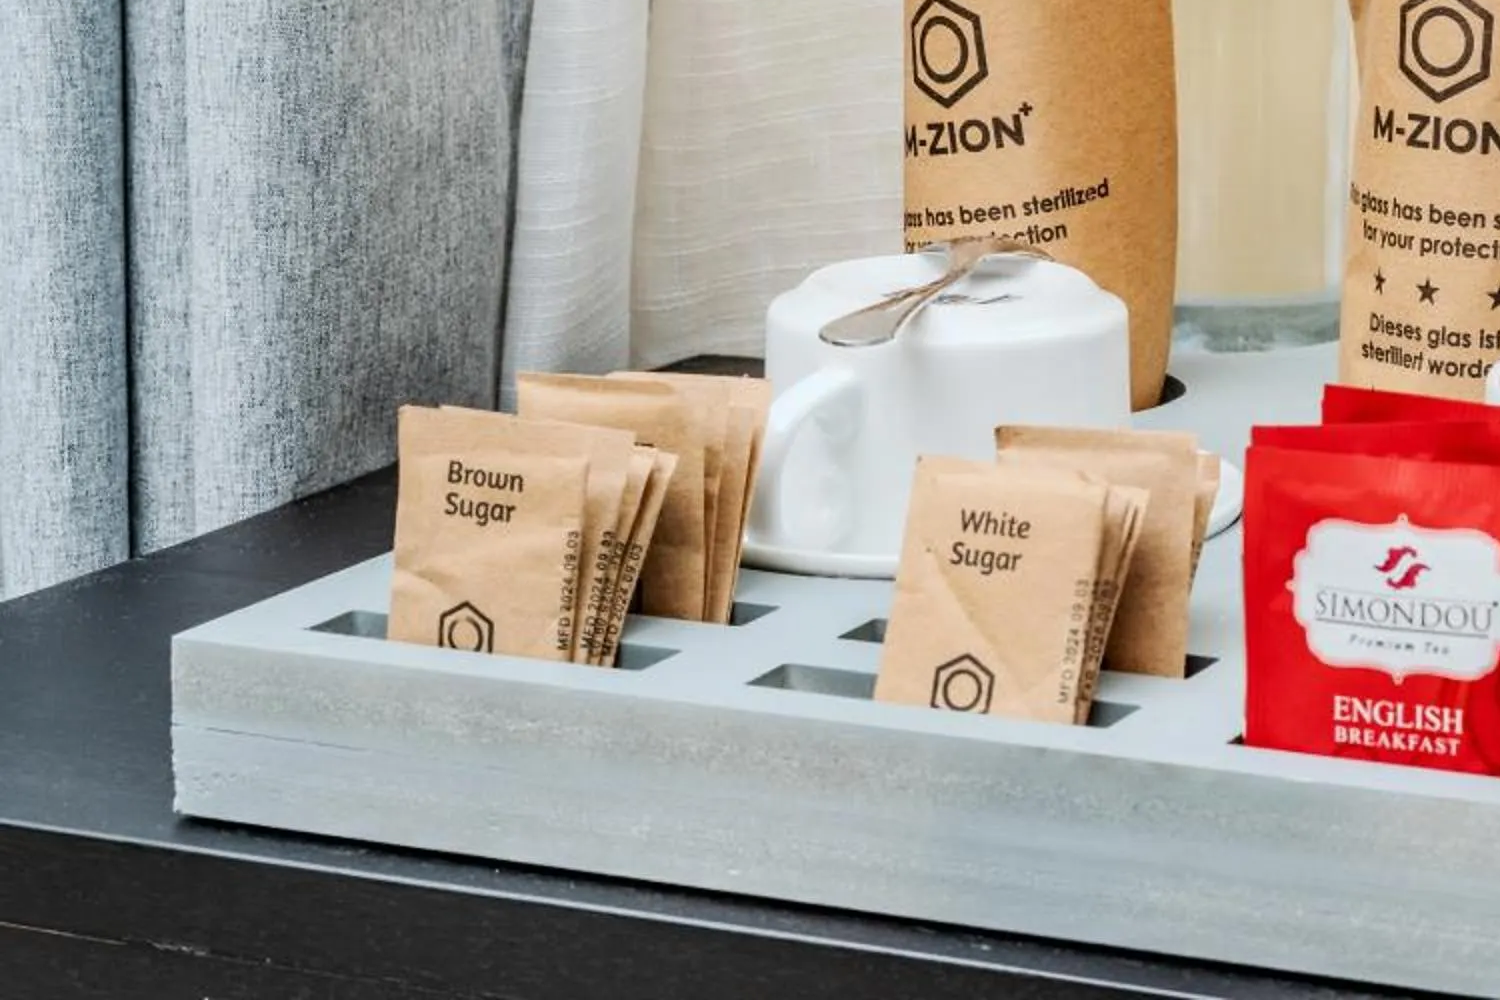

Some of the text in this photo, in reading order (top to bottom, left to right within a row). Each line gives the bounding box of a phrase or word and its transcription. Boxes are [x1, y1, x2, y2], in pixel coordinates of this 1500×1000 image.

[925, 207, 954, 227] has
[959, 203, 1016, 225] been
[1022, 178, 1109, 217] sterilized
[1361, 191, 1389, 214] glass
[1392, 197, 1423, 222] has
[1429, 204, 1486, 228] been
[1381, 227, 1415, 250] your
[1369, 311, 1422, 342] Dieses
[1427, 325, 1472, 349] glas
[447, 461, 524, 493] Brown
[444, 493, 517, 526] Sugar
[961, 509, 1032, 540] White
[950, 542, 1023, 575] Sugar
[1316, 589, 1493, 633] SIMONDOU
[557, 617, 571, 651] MFD
[1333, 695, 1464, 735] ENGLISH
[1334, 725, 1461, 757] BREAKFAST
